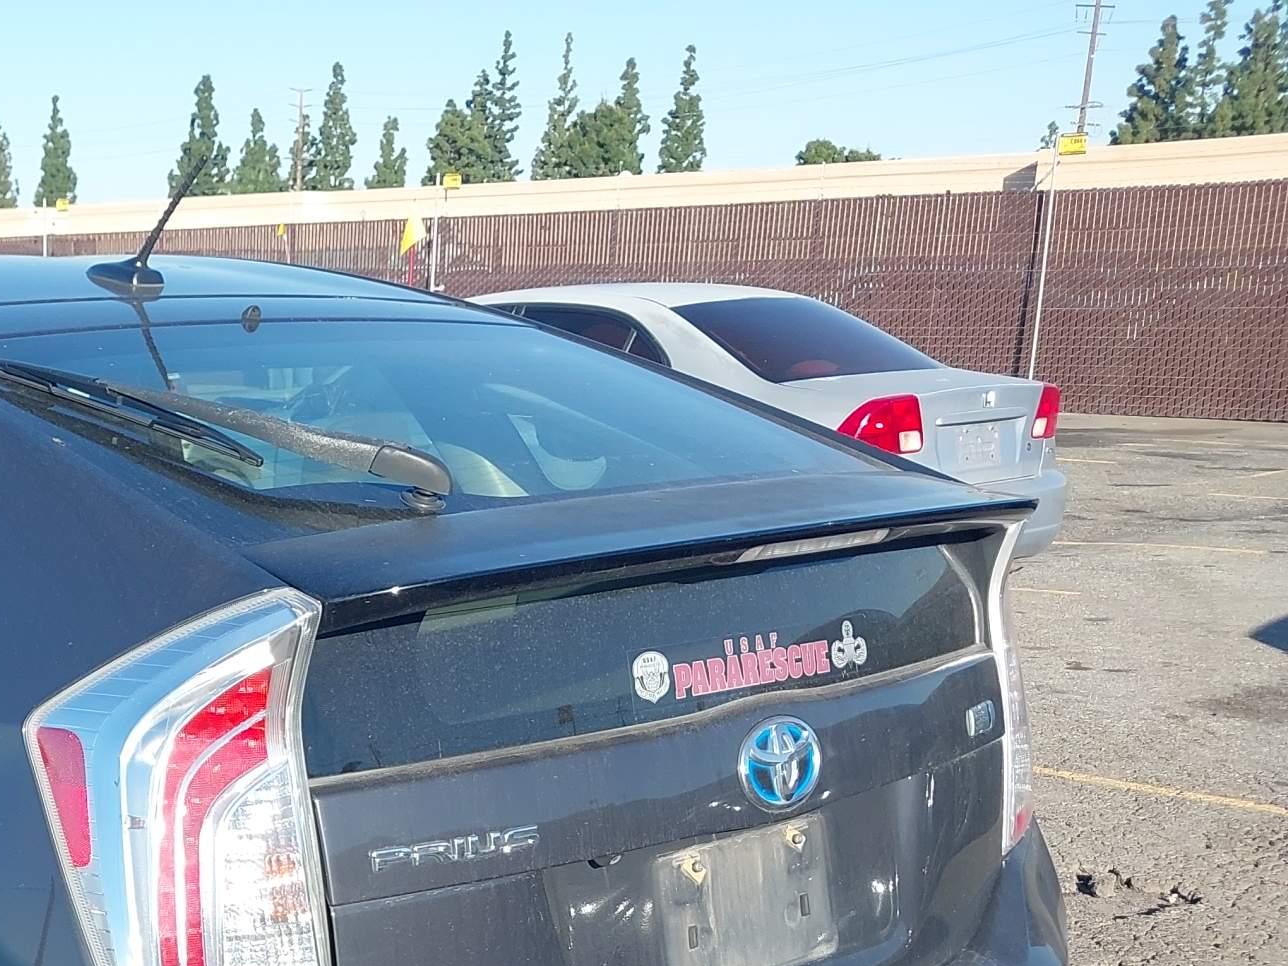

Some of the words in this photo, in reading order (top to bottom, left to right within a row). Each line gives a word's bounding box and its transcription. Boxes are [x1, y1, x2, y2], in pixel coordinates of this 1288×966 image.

[723, 632, 778, 656] USAF
[673, 639, 831, 700] PARARESCUE
[368, 824, 540, 873] PRIUS
